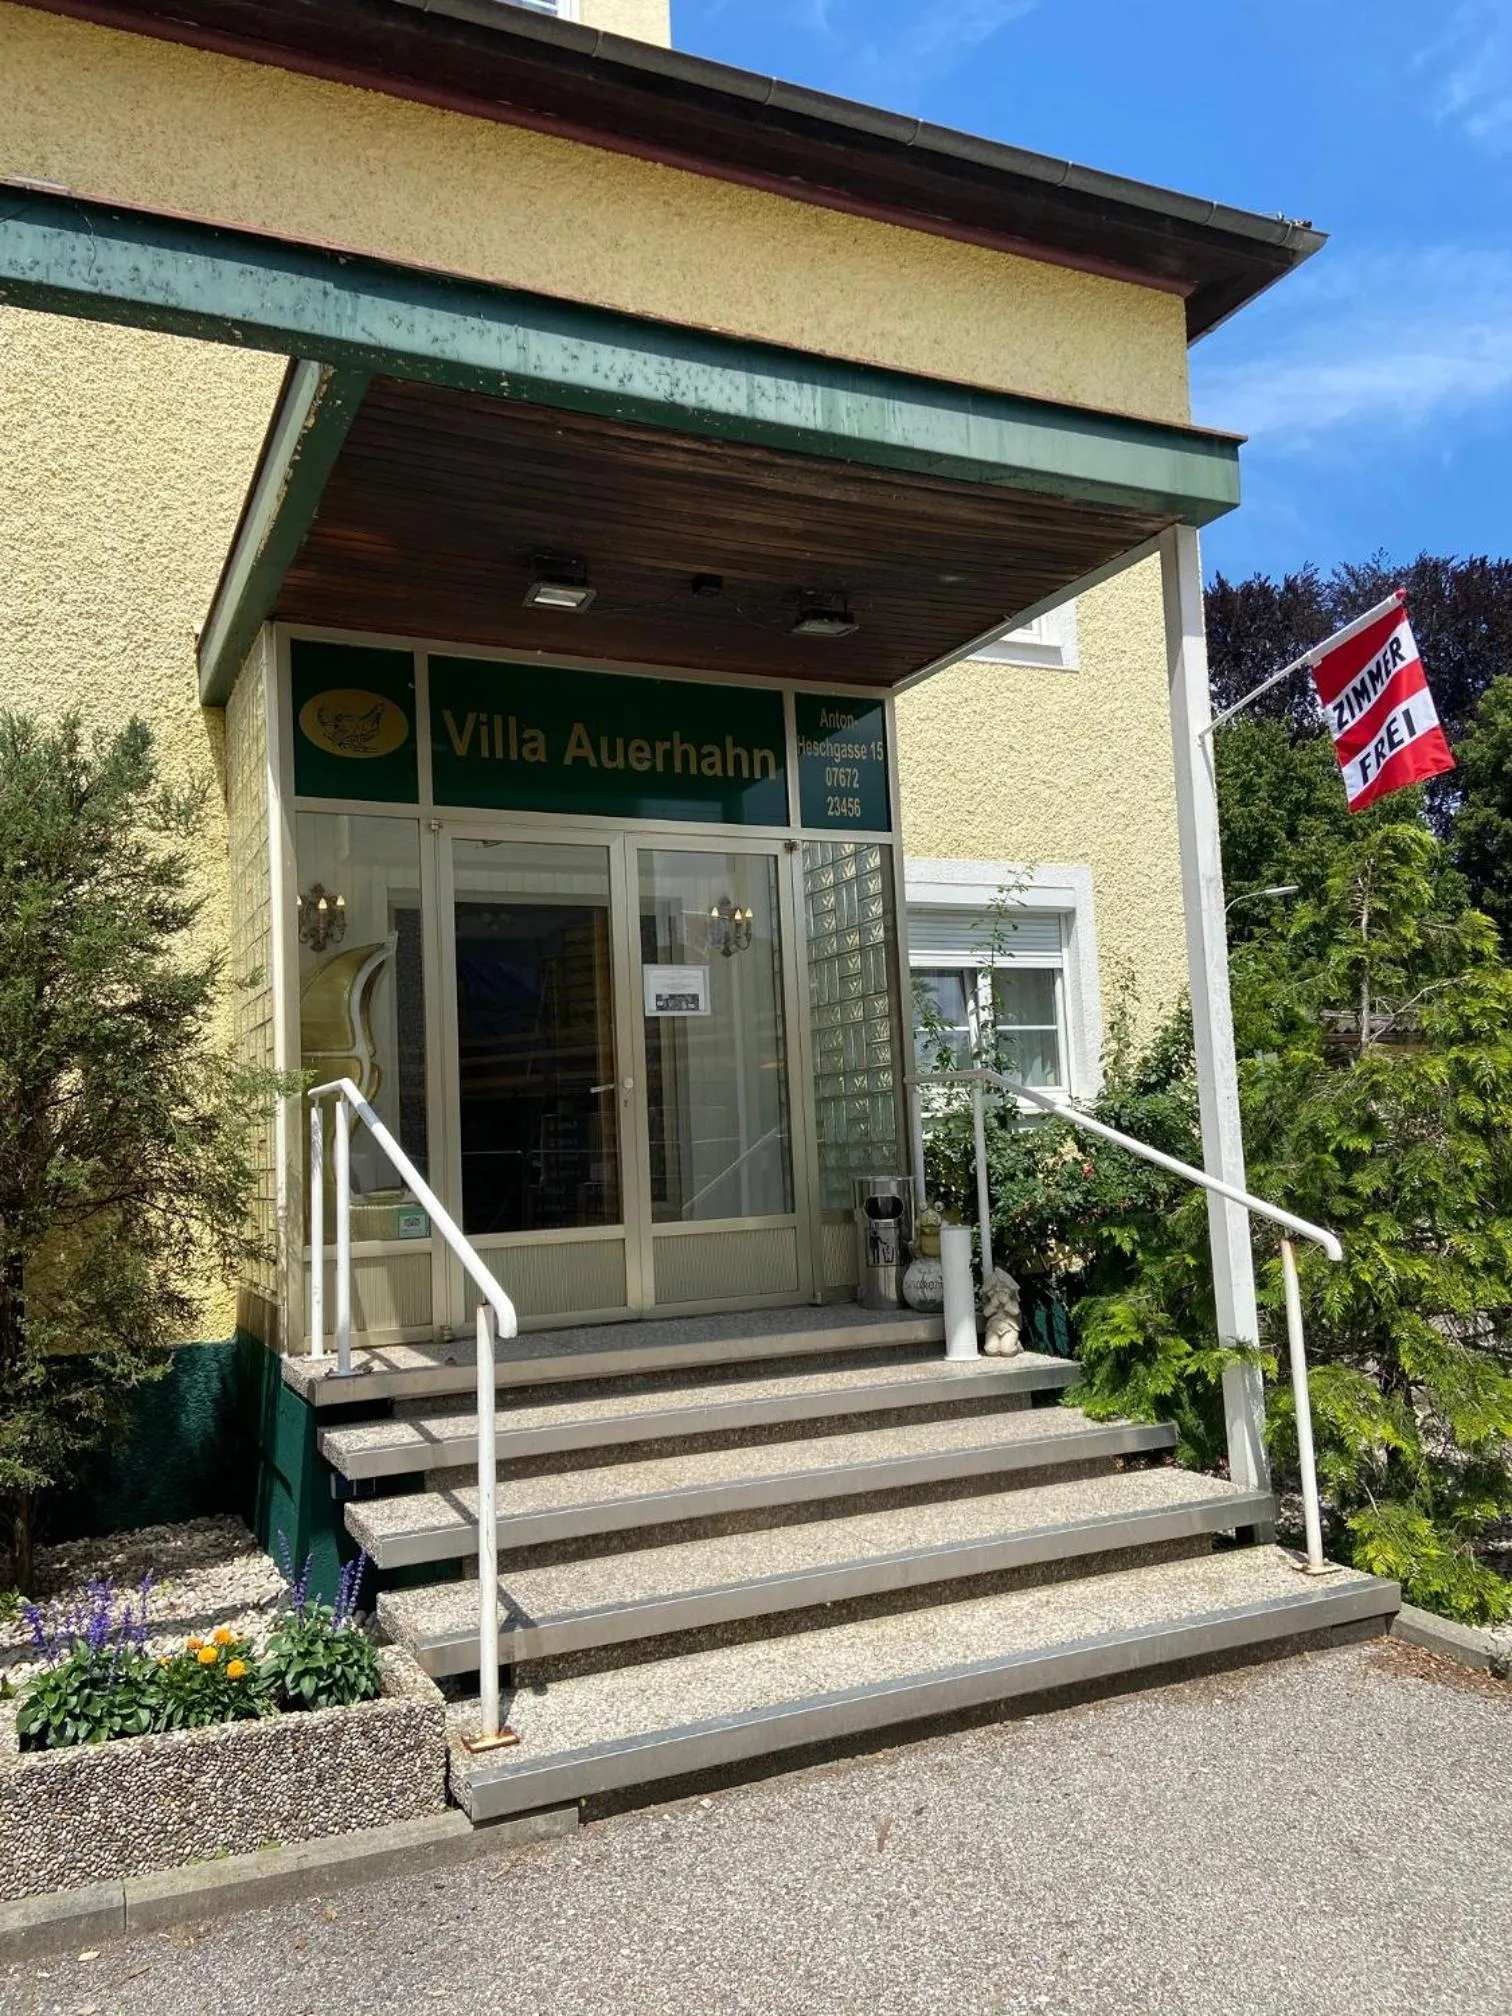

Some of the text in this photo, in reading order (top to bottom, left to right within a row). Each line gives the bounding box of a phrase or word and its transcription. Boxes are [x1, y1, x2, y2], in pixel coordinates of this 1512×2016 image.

[1332, 636, 1407, 731] ZIMMER
[442, 708, 777, 780] Villa Auerhahn
[798, 736, 884, 762] Heschgasse 15
[1358, 708, 1417, 785] FREI
[825, 767, 860, 788] 07672
[827, 796, 861, 817] 23456
